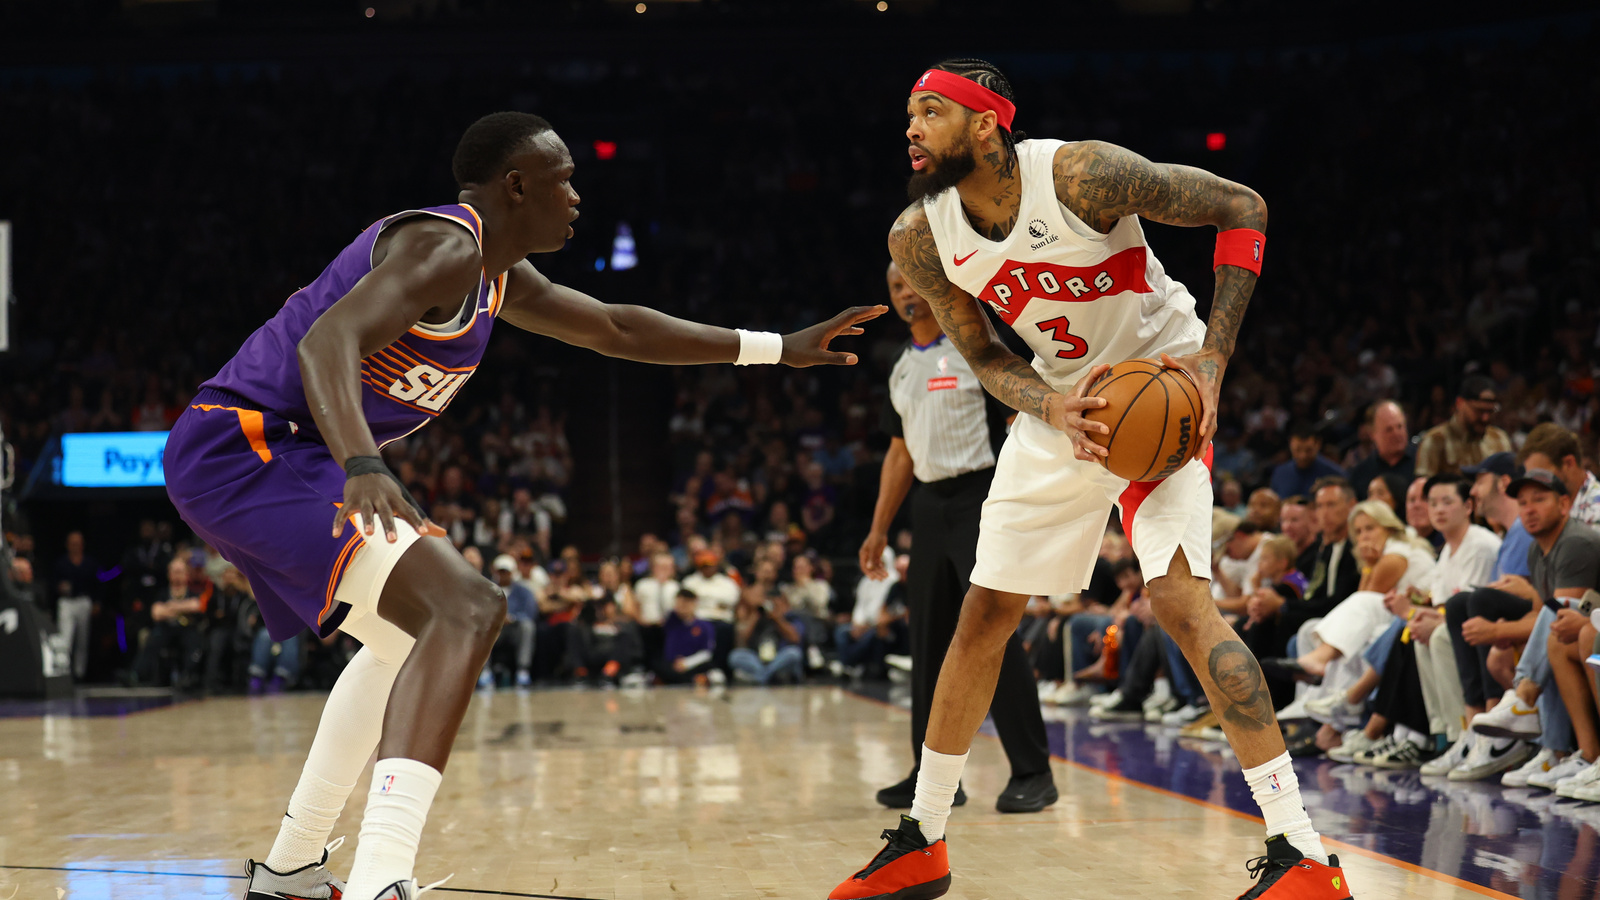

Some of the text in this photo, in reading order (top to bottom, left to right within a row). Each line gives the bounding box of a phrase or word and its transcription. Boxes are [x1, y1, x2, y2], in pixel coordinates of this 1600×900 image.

[1030, 234, 1060, 251] Sun Life
[1035, 315, 1089, 359] 3
[388, 364, 476, 413] SU
